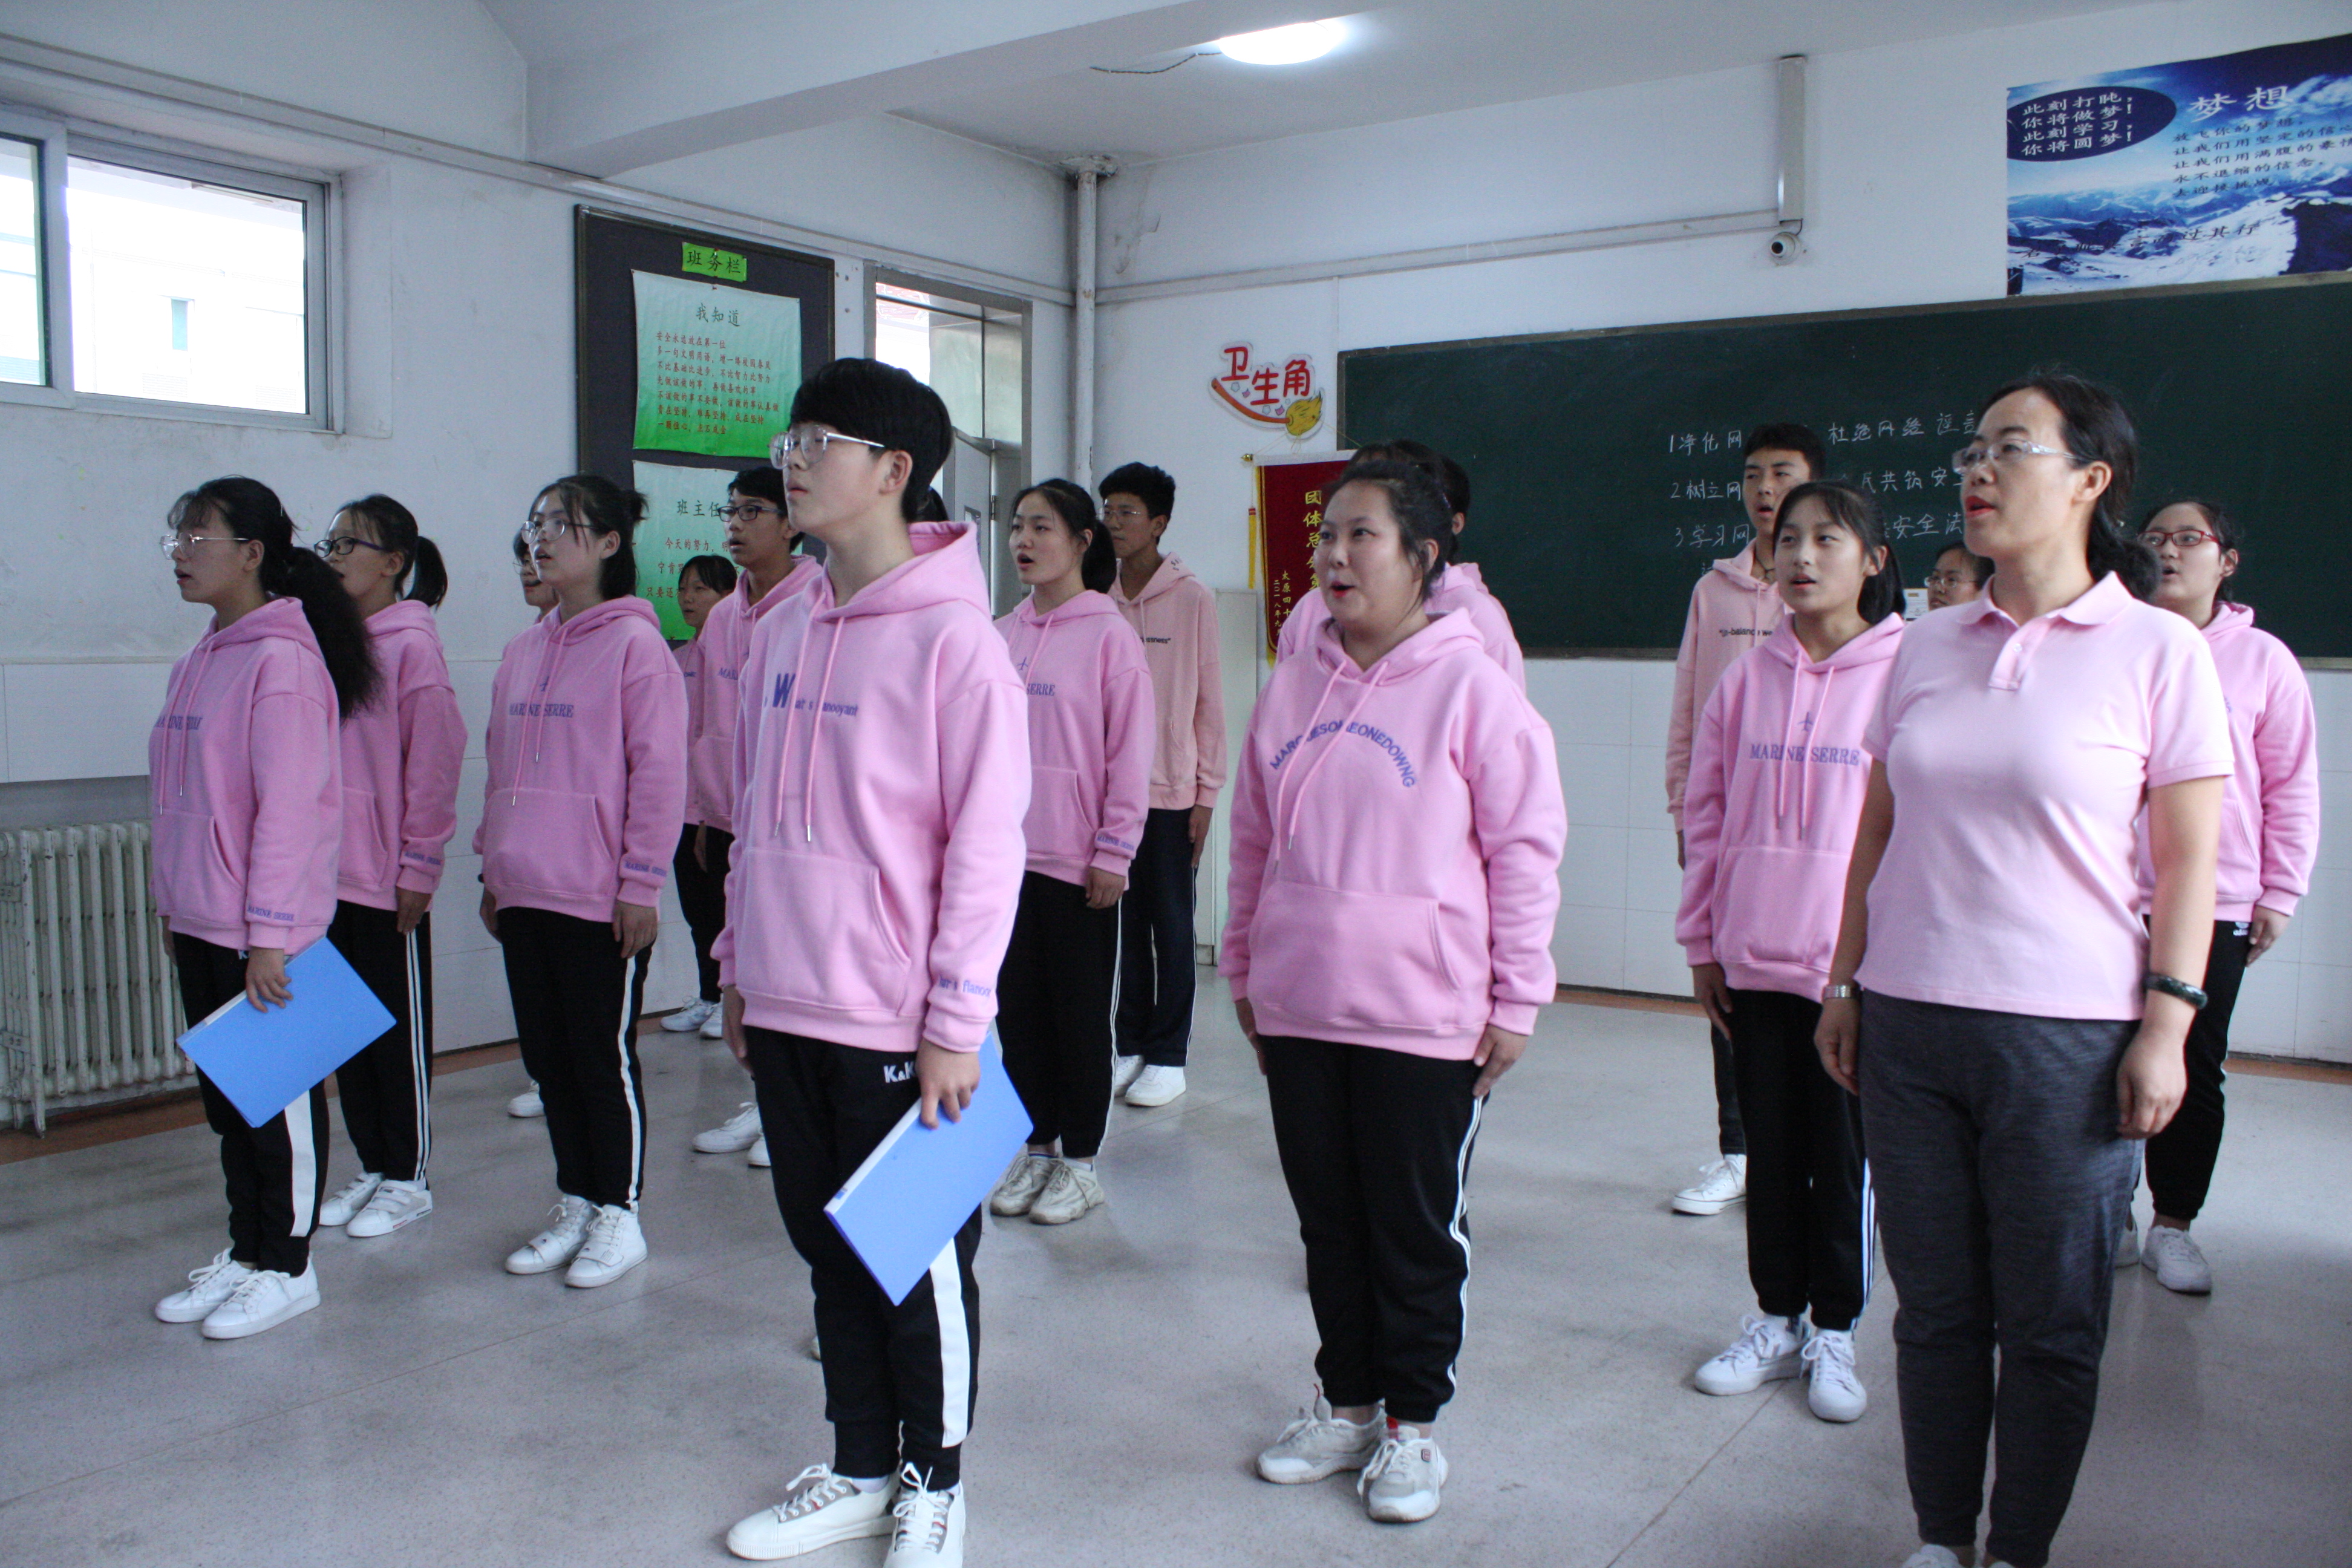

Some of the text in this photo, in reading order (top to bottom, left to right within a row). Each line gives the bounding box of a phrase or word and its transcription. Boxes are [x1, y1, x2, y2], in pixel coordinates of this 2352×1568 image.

[2189, 85, 2295, 123] 梦想
[687, 250, 741, 274] 班务栏
[696, 302, 741, 327] 我知道
[1221, 345, 1312, 407] 卫生角
[1884, 511, 1964, 540] 安全法
[509, 703, 541, 717] MARNE
[1811, 746, 1860, 766] SERRE
